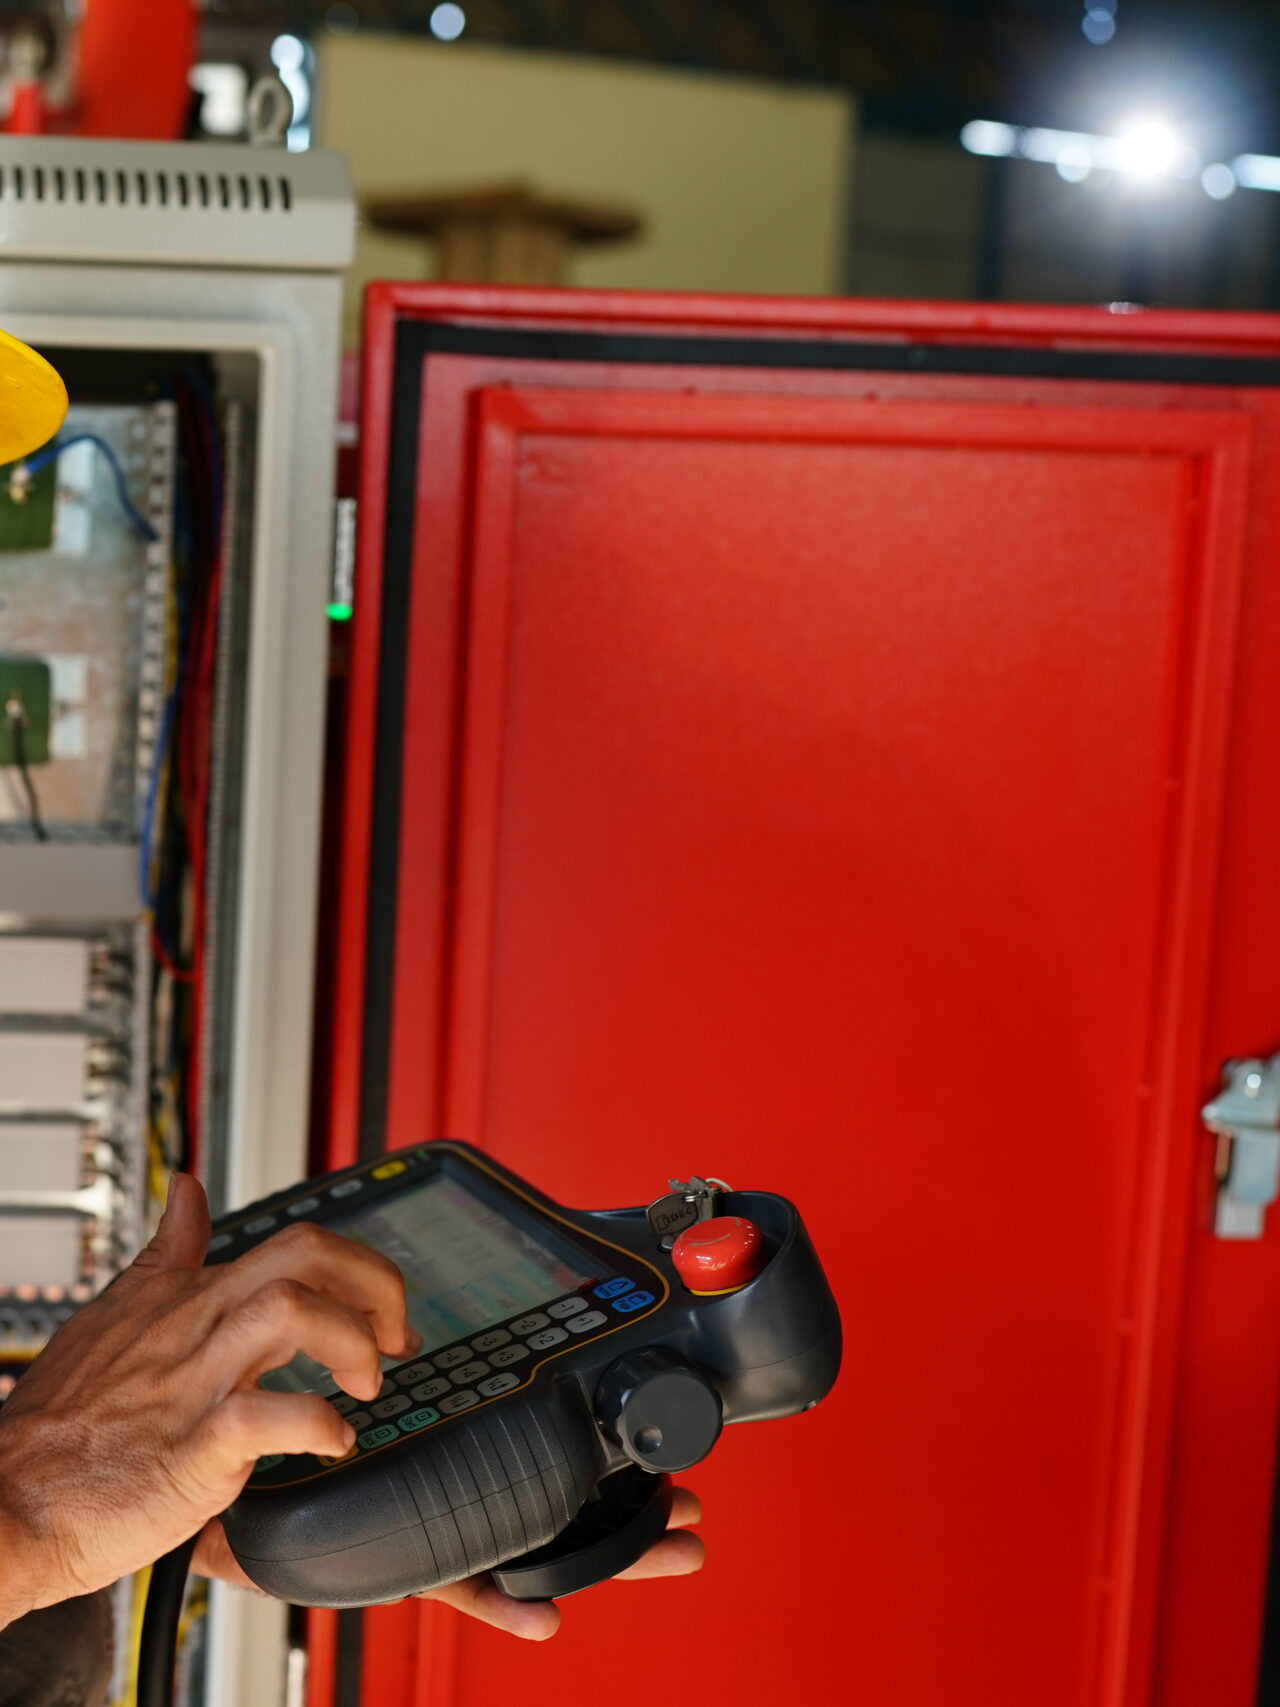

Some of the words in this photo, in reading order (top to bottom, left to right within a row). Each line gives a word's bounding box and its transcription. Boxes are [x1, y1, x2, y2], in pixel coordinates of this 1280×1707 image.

[561, 1303, 575, 1313] -1
[521, 1320, 537, 1330] -2
[577, 1317, 594, 1327] +1
[483, 1336, 497, 1346] -3
[538, 1333, 555, 1345] +2
[447, 1352, 460, 1362] -4
[498, 1351, 514, 1362] +3
[407, 1369, 422, 1379] -5
[463, 1367, 477, 1378] +4
[423, 1384, 438, 1395] +5
